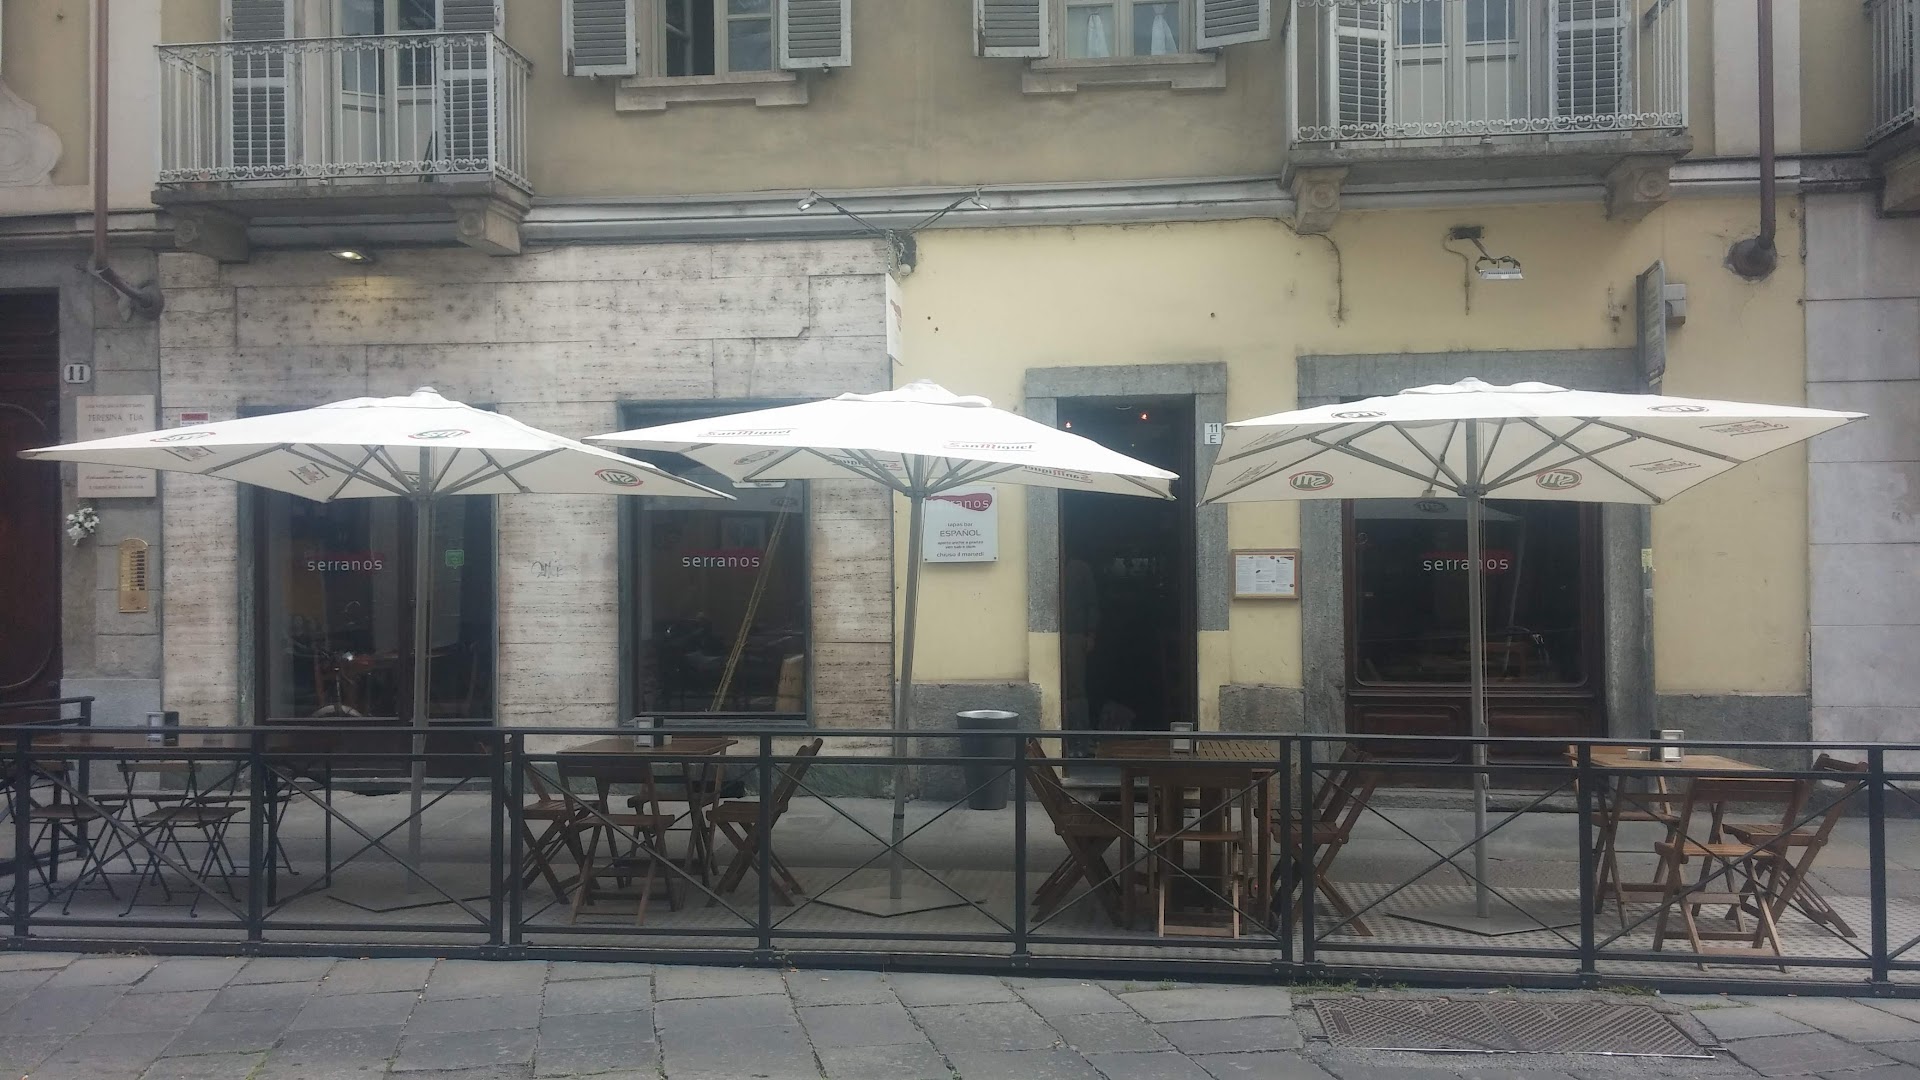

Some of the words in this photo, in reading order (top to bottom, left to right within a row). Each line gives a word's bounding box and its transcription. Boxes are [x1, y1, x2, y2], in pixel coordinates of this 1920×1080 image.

[69, 365, 84, 381] 11
[129, 413, 144, 421] TUA
[1209, 423, 1218, 433] 11
[1209, 434, 1217, 444] E
[939, 528, 982, 537] ESPAÑOL
[307, 559, 383, 572] serranos
[682, 555, 760, 568] serranos
